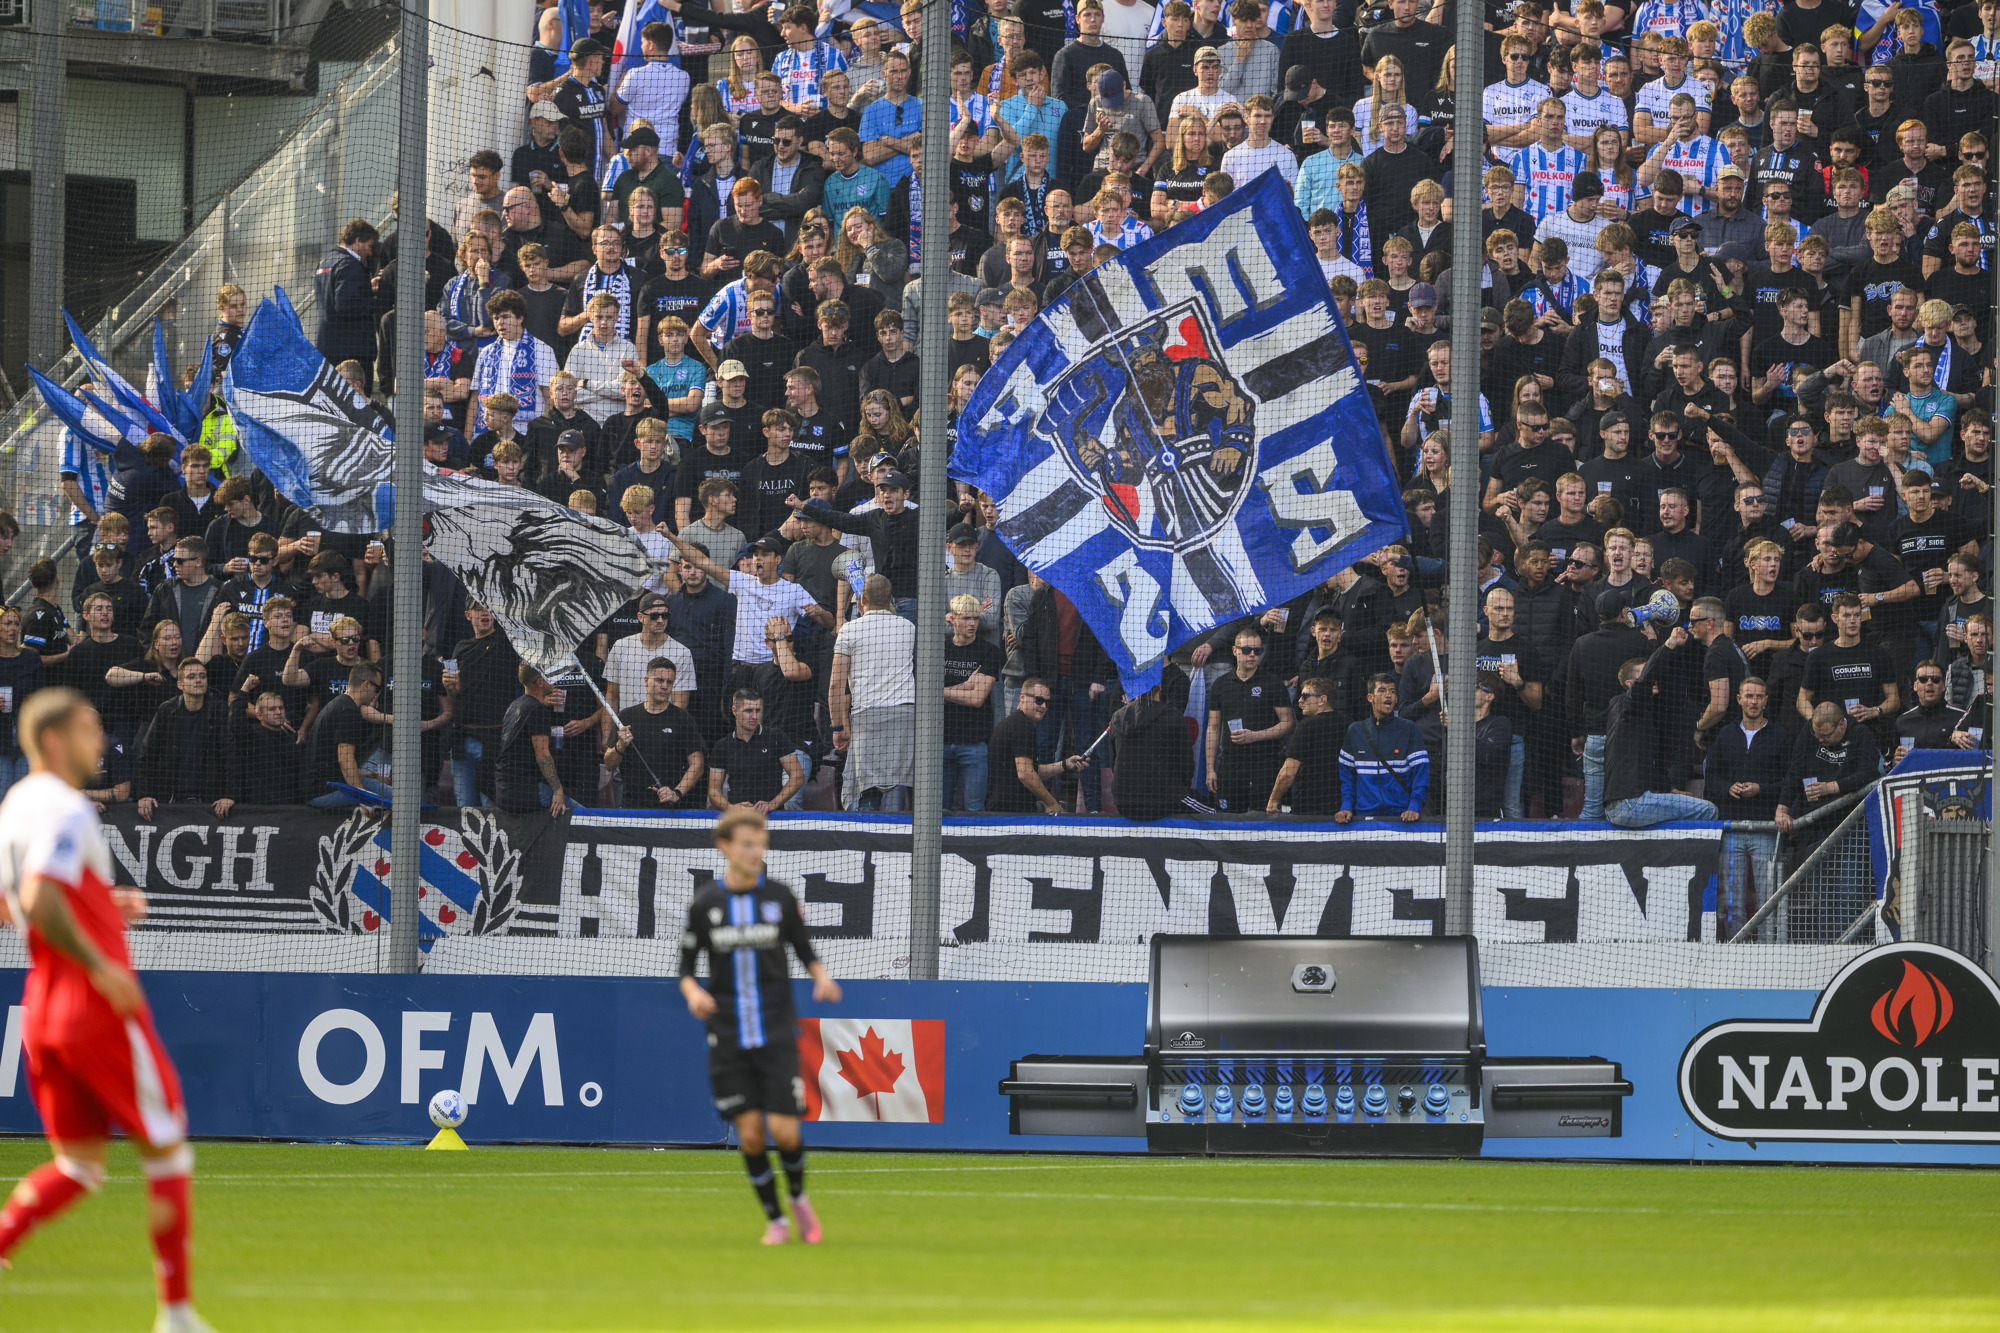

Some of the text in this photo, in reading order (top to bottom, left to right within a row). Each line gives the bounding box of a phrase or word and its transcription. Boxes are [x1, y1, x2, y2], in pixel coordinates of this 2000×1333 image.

[1651, 17, 1679, 26] WOLK
[1493, 106, 1531, 115] WOLKOM
[1652, 111, 1670, 119] WOL
[1664, 158, 1704, 168] WOLKOM
[1531, 171, 1573, 181] WOLKOM
[1757, 170, 1794, 181] WOLKOM
[1600, 344, 1623, 353] OLKO
[944, 668, 973, 677] FFENDE
[1834, 666, 1862, 674] casuals
[104, 824, 279, 892] NGH
[1718, 1055, 2000, 1112] NAPOLE
